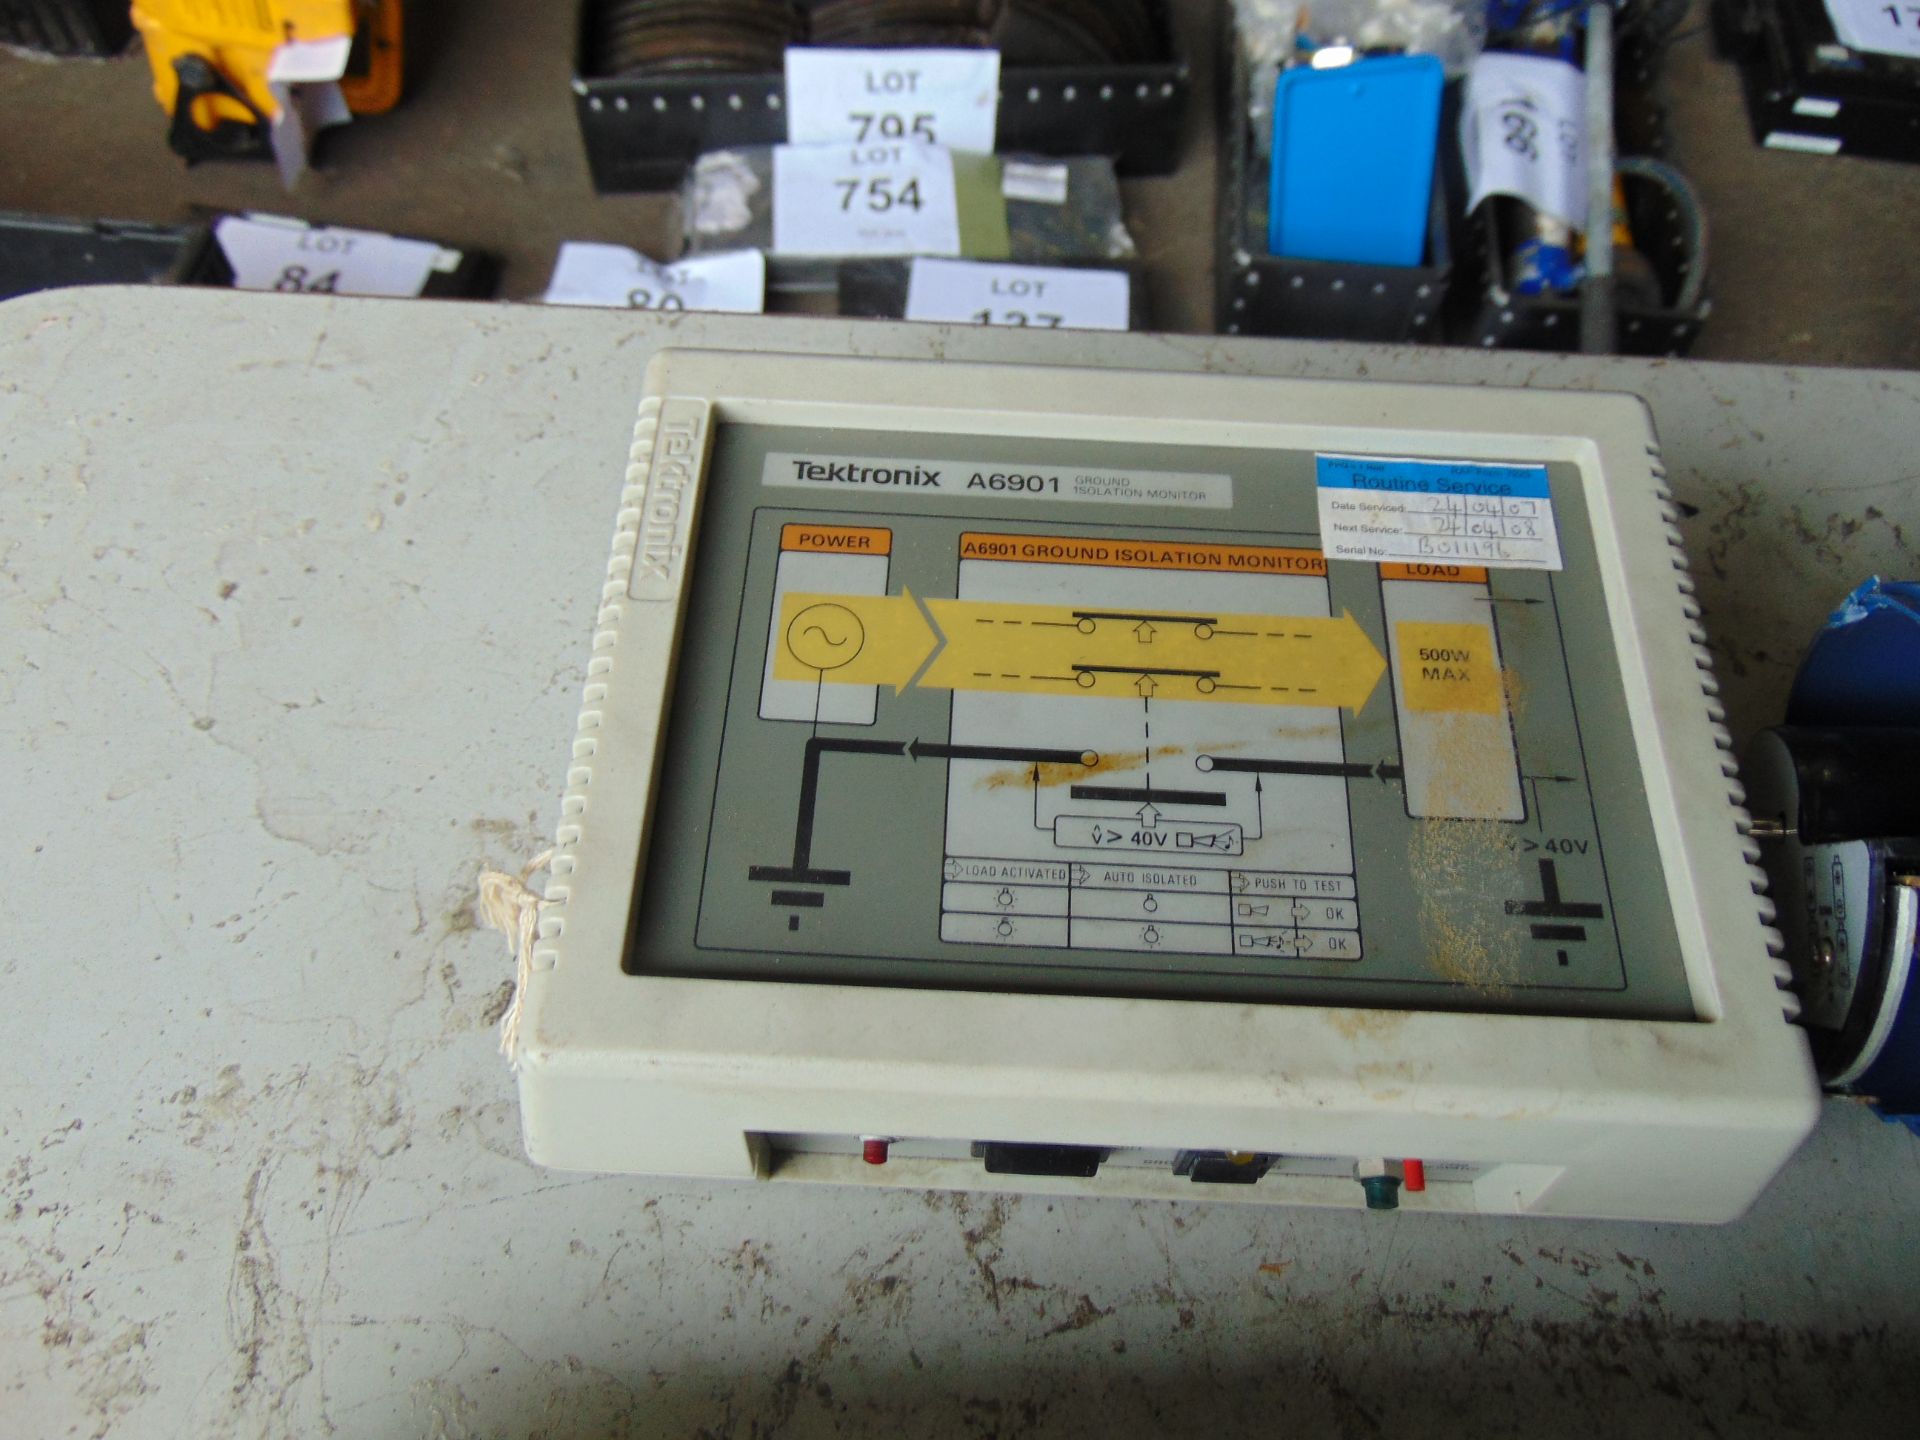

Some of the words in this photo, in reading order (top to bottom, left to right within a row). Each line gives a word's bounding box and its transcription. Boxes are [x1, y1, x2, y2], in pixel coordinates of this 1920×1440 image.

[866, 70, 921, 93] LOT
[852, 147, 903, 166] LOT
[833, 175, 924, 213] 754
[296, 234, 356, 255] LOT
[274, 264, 341, 292] 84
[991, 278, 1047, 298] LOT
[793, 460, 942, 488] Tektronix
[967, 473, 1059, 493] A6901
[1075, 474, 1130, 487] GROUND
[1352, 473, 1429, 493] Routine
[1437, 477, 1512, 496] Service
[1074, 486, 1142, 498] ISOLATION
[1147, 489, 1207, 501] MONITOR
[1331, 501, 1356, 511] Date
[1333, 522, 1358, 533] Next
[799, 533, 871, 549] POWER
[1336, 544, 1366, 554] Serial
[963, 542, 1017, 556] A6901
[1022, 544, 1109, 560] GROUND
[1115, 548, 1222, 566] ISOLATION
[1228, 553, 1323, 571] MONITOR
[1406, 563, 1461, 577] LOAD
[1419, 648, 1470, 662] 500W
[1422, 667, 1471, 682] MAX
[1131, 831, 1168, 847] 40V
[1545, 837, 1588, 854] 40V
[966, 867, 997, 877] LOAD
[1001, 868, 1066, 880] ACTIVATED
[1104, 871, 1135, 883] AUTO
[1142, 874, 1198, 887] ISOLATED
[1255, 878, 1287, 890] PUSH
[1294, 880, 1308, 891] TO
[1315, 881, 1342, 891] TEST
[1326, 906, 1345, 920] OK
[1328, 937, 1348, 950] OK
